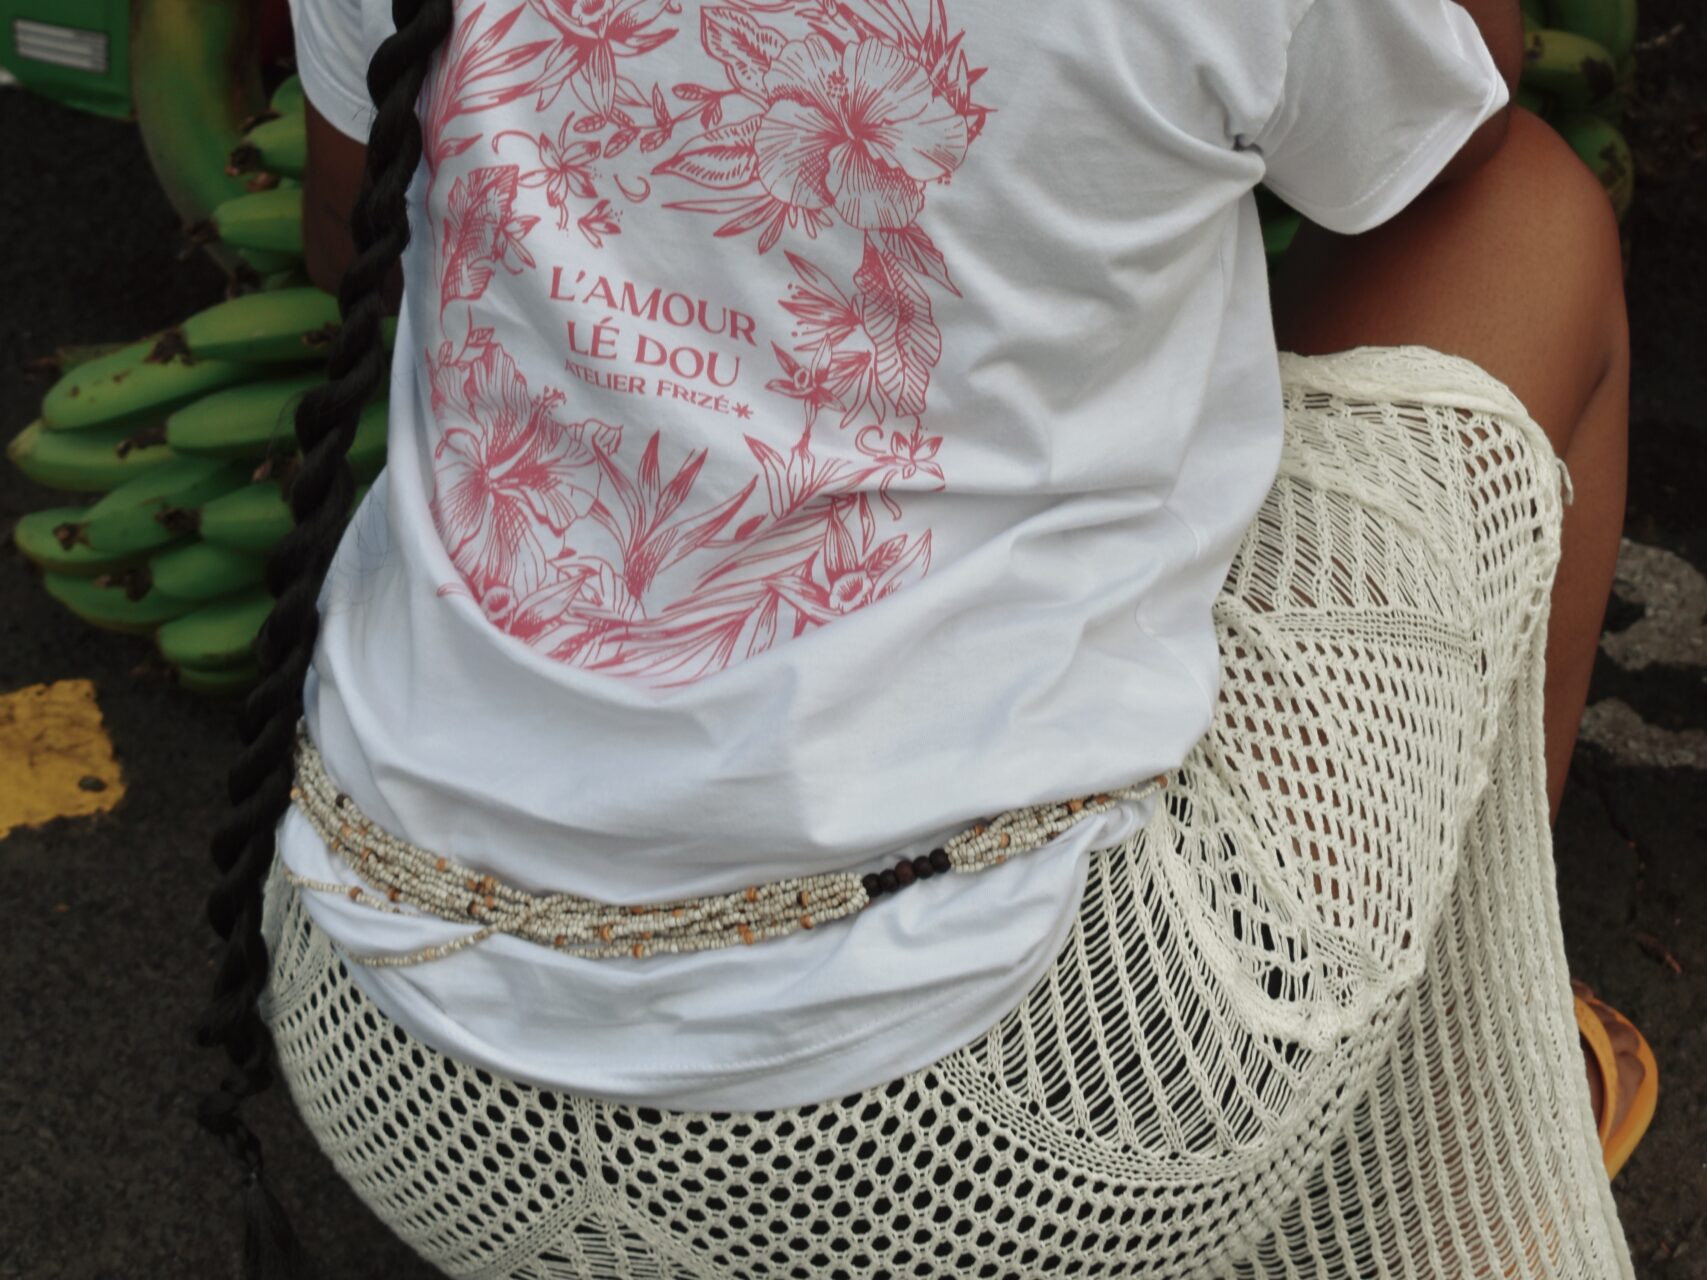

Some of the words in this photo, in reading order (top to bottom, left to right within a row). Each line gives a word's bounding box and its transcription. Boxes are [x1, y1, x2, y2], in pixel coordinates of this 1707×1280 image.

[564, 358, 646, 395] ATELIER
[567, 316, 620, 360] LÉ
[634, 333, 741, 388] DOU
